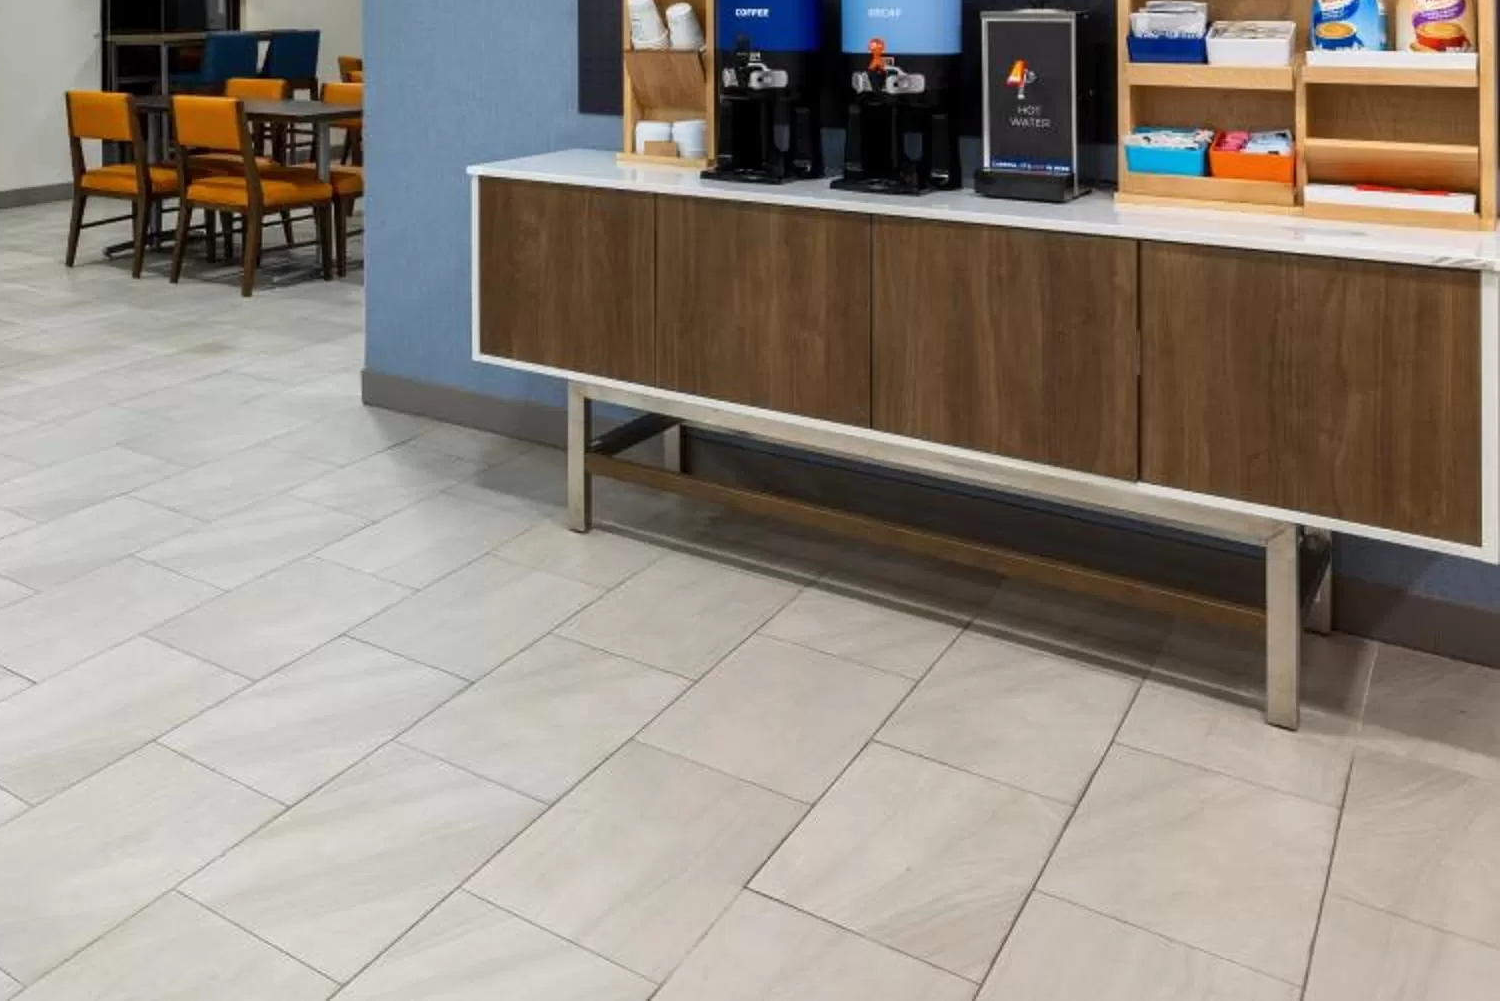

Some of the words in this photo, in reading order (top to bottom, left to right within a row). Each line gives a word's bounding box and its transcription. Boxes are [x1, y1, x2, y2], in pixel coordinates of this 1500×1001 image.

[735, 8, 770, 18] COFFEE
[1018, 105, 1042, 116] HOT
[1010, 118, 1051, 128] WATER
